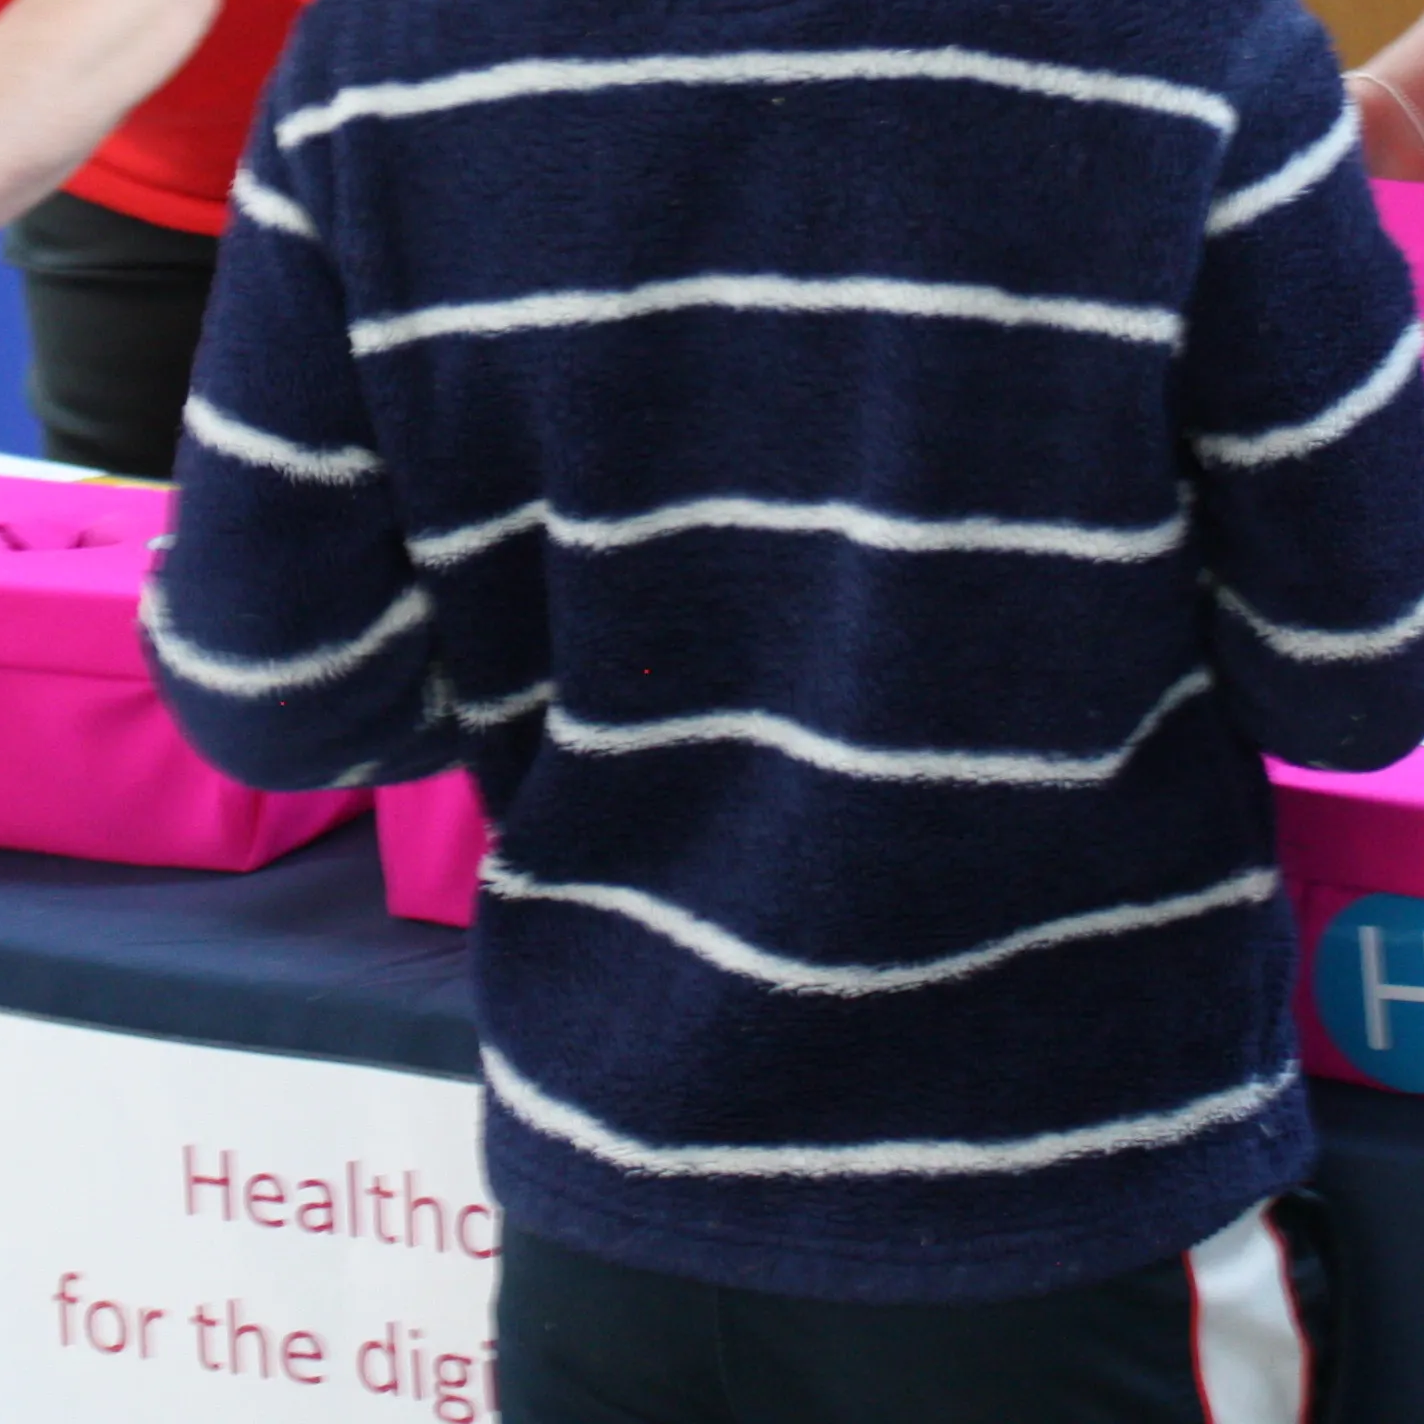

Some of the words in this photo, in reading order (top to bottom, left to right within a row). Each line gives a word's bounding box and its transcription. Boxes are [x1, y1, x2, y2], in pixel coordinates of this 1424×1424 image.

[182, 1143, 502, 1259] Healthc
[53, 1272, 165, 1359] for
[190, 1298, 326, 1384] the
